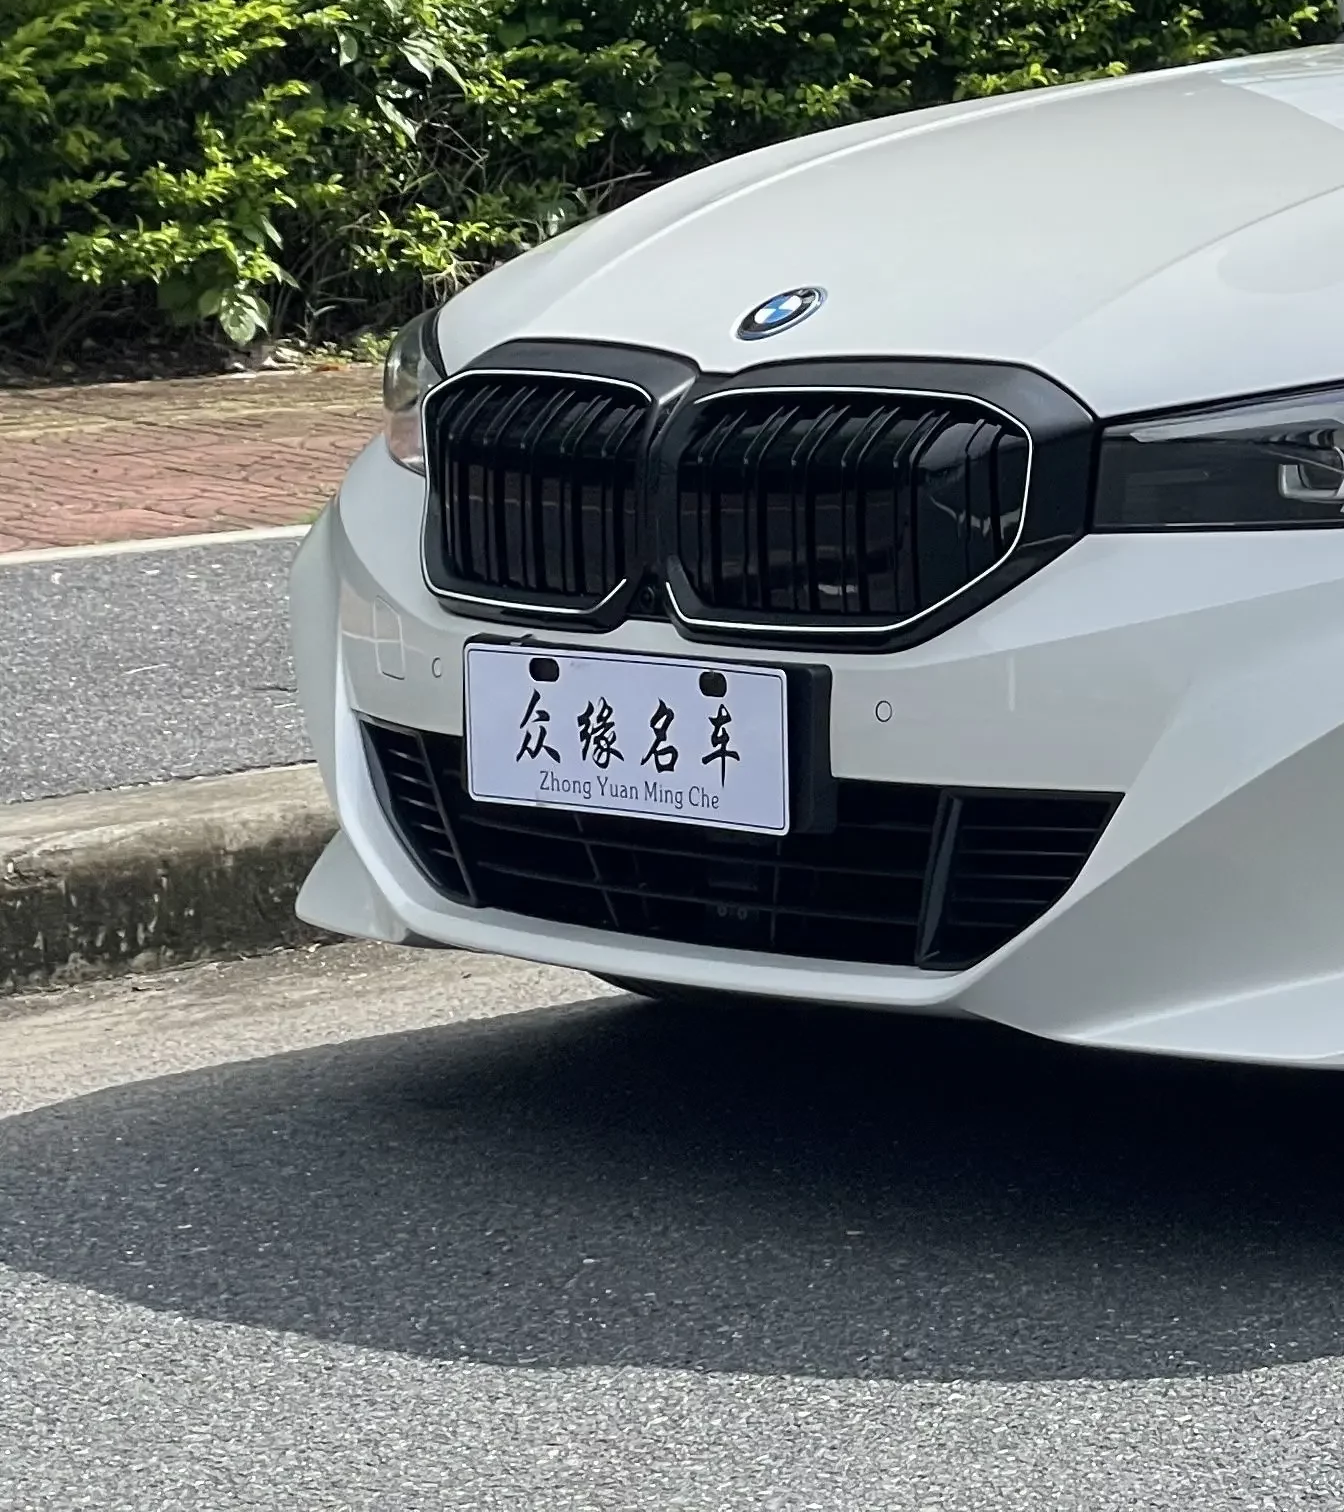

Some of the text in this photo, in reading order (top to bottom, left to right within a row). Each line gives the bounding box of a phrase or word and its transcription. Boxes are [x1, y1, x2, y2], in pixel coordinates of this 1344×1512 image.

[516, 689, 740, 787] 众缘名车
[540, 770, 720, 809] Zhong Yuan Ming Che
